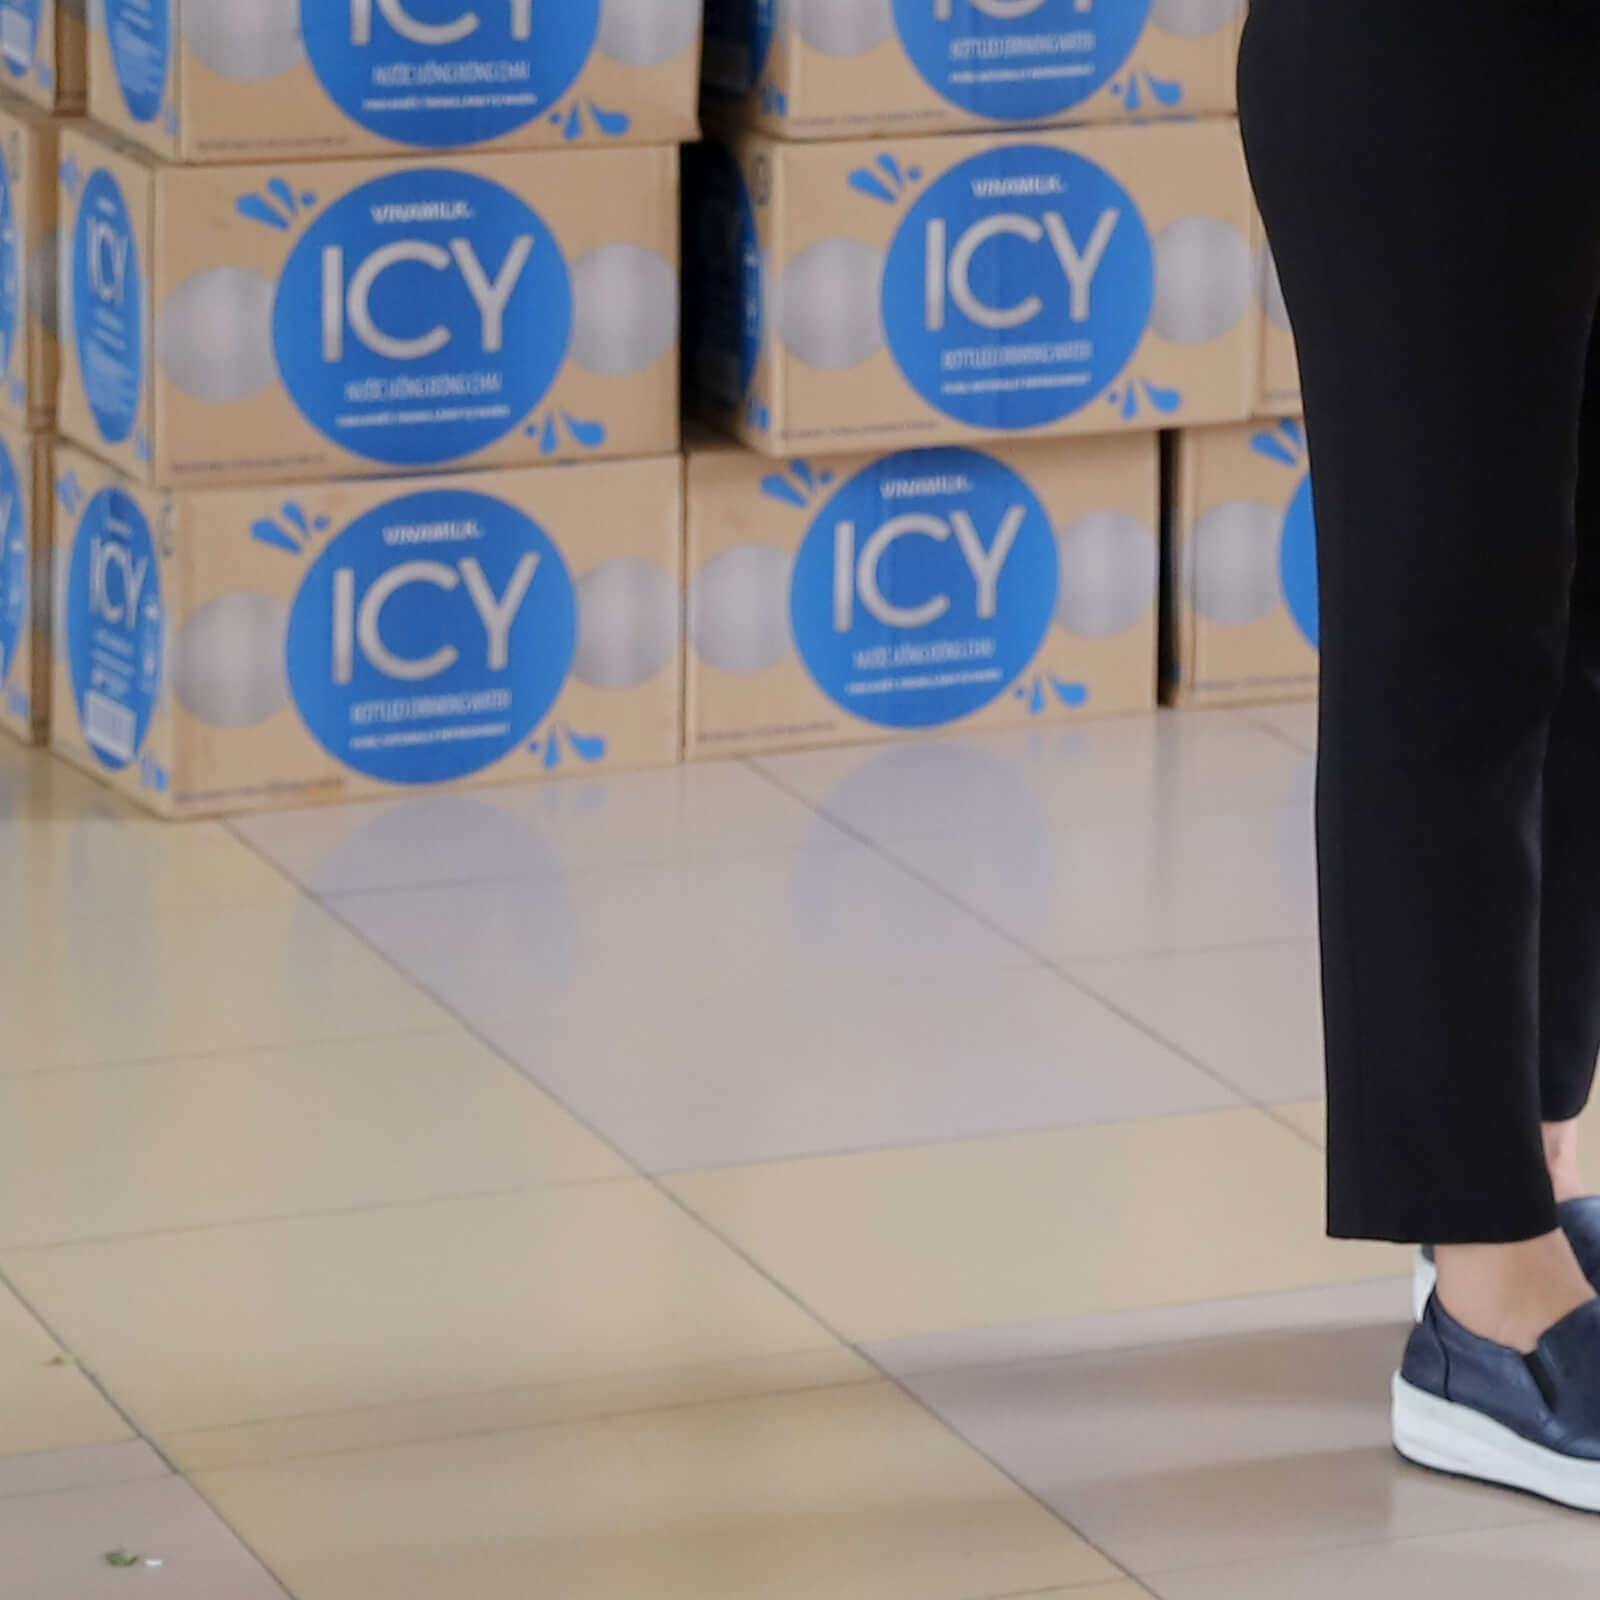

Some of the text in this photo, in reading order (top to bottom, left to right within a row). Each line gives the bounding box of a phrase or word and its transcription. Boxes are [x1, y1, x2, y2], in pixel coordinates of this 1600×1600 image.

[372, 201, 471, 223] VINAMILK
[972, 175, 1063, 197] VINAMILK
[322, 235, 534, 362] ICY
[926, 208, 1120, 331] ICY
[383, 521, 480, 544] VINAMILK
[881, 474, 969, 498] VINAMILK
[91, 535, 149, 629] ICY
[834, 506, 1025, 631] ICY
[333, 553, 540, 684] ICY
